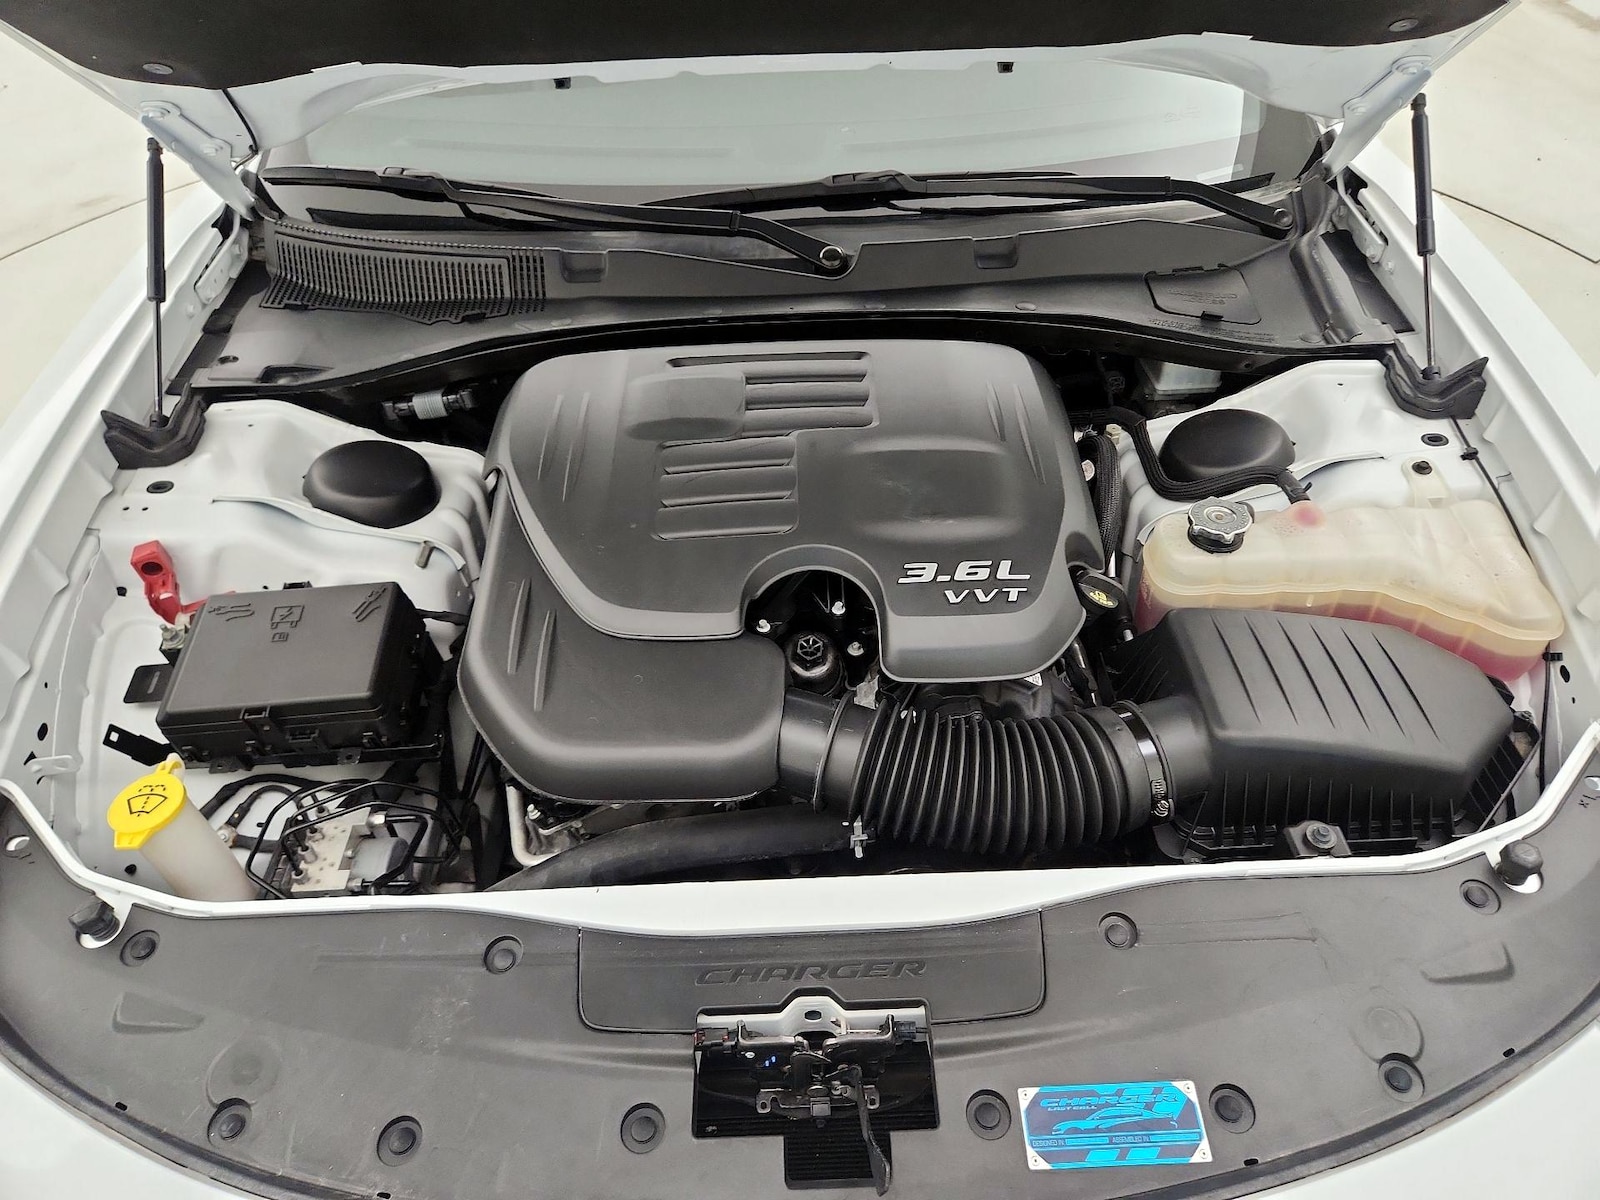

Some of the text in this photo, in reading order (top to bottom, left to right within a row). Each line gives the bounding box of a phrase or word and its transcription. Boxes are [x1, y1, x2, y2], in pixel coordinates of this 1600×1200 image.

[897, 560, 1031, 584] 3.6L
[943, 587, 1028, 604] VVT
[694, 960, 927, 986] CHARGER
[1040, 1093, 1178, 1107] CHARGER
